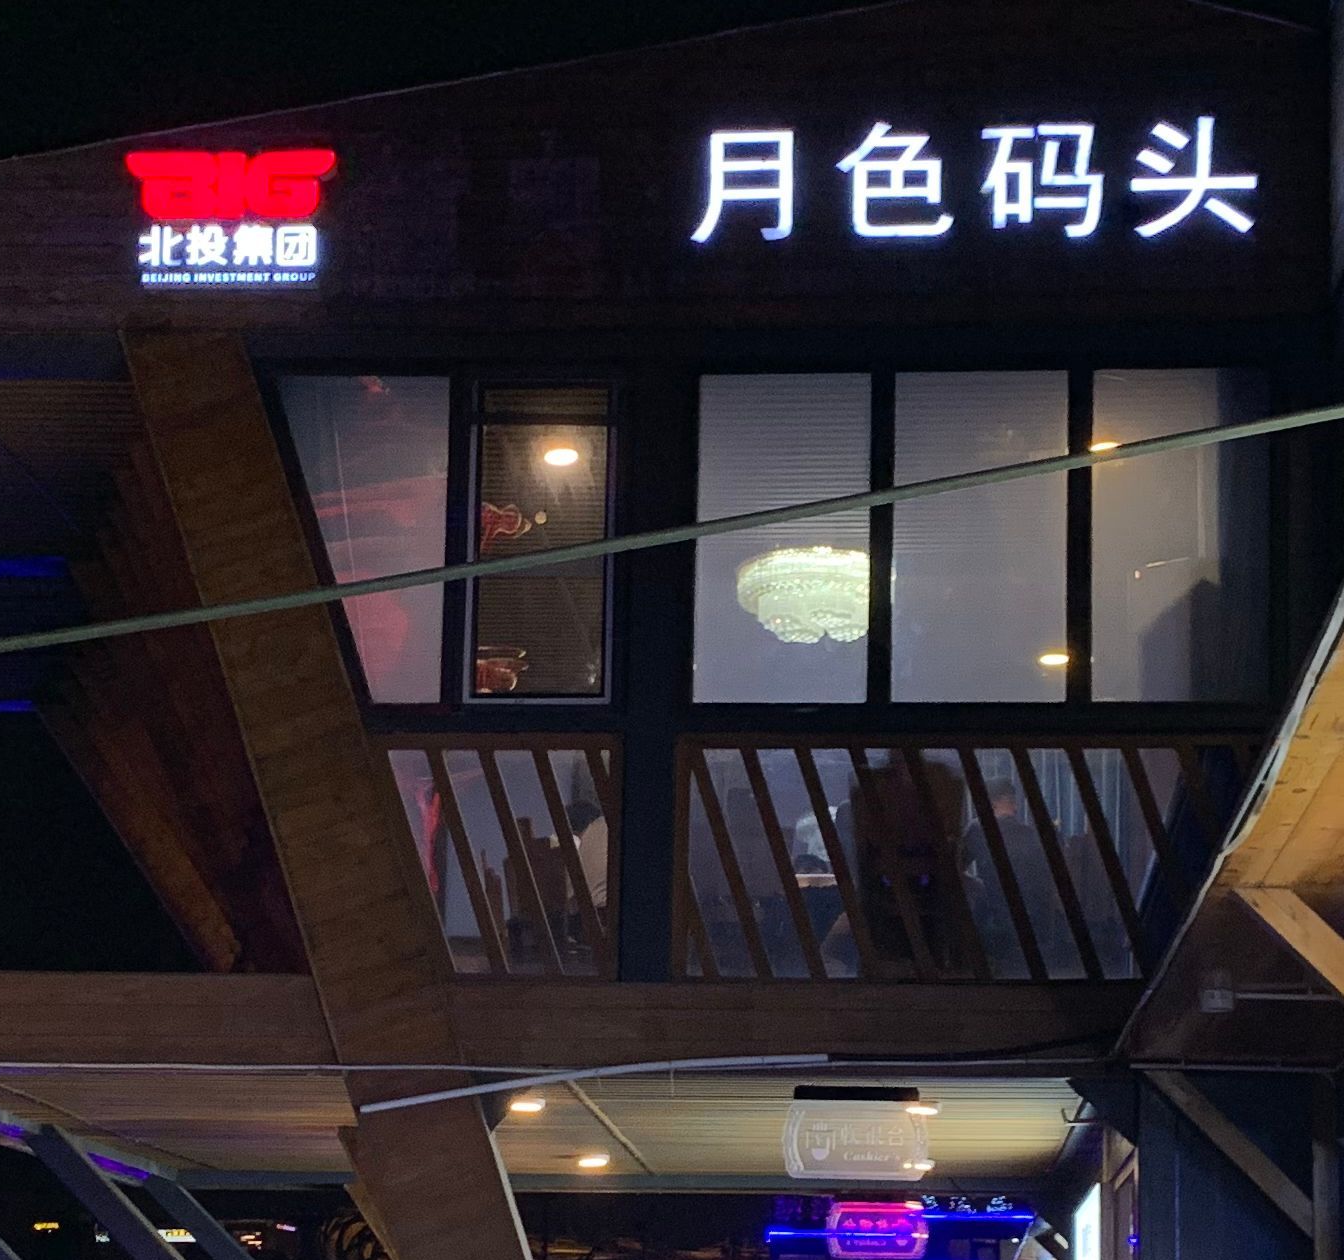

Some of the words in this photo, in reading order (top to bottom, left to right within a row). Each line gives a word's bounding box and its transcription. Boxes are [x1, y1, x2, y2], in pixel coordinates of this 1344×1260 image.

[692, 115, 1260, 244] 月色码头
[138, 224, 317, 267] 北投集团
[141, 273, 191, 283] BEIJING
[193, 272, 270, 283] INVESTMENT
[272, 272, 316, 282] GROUP
